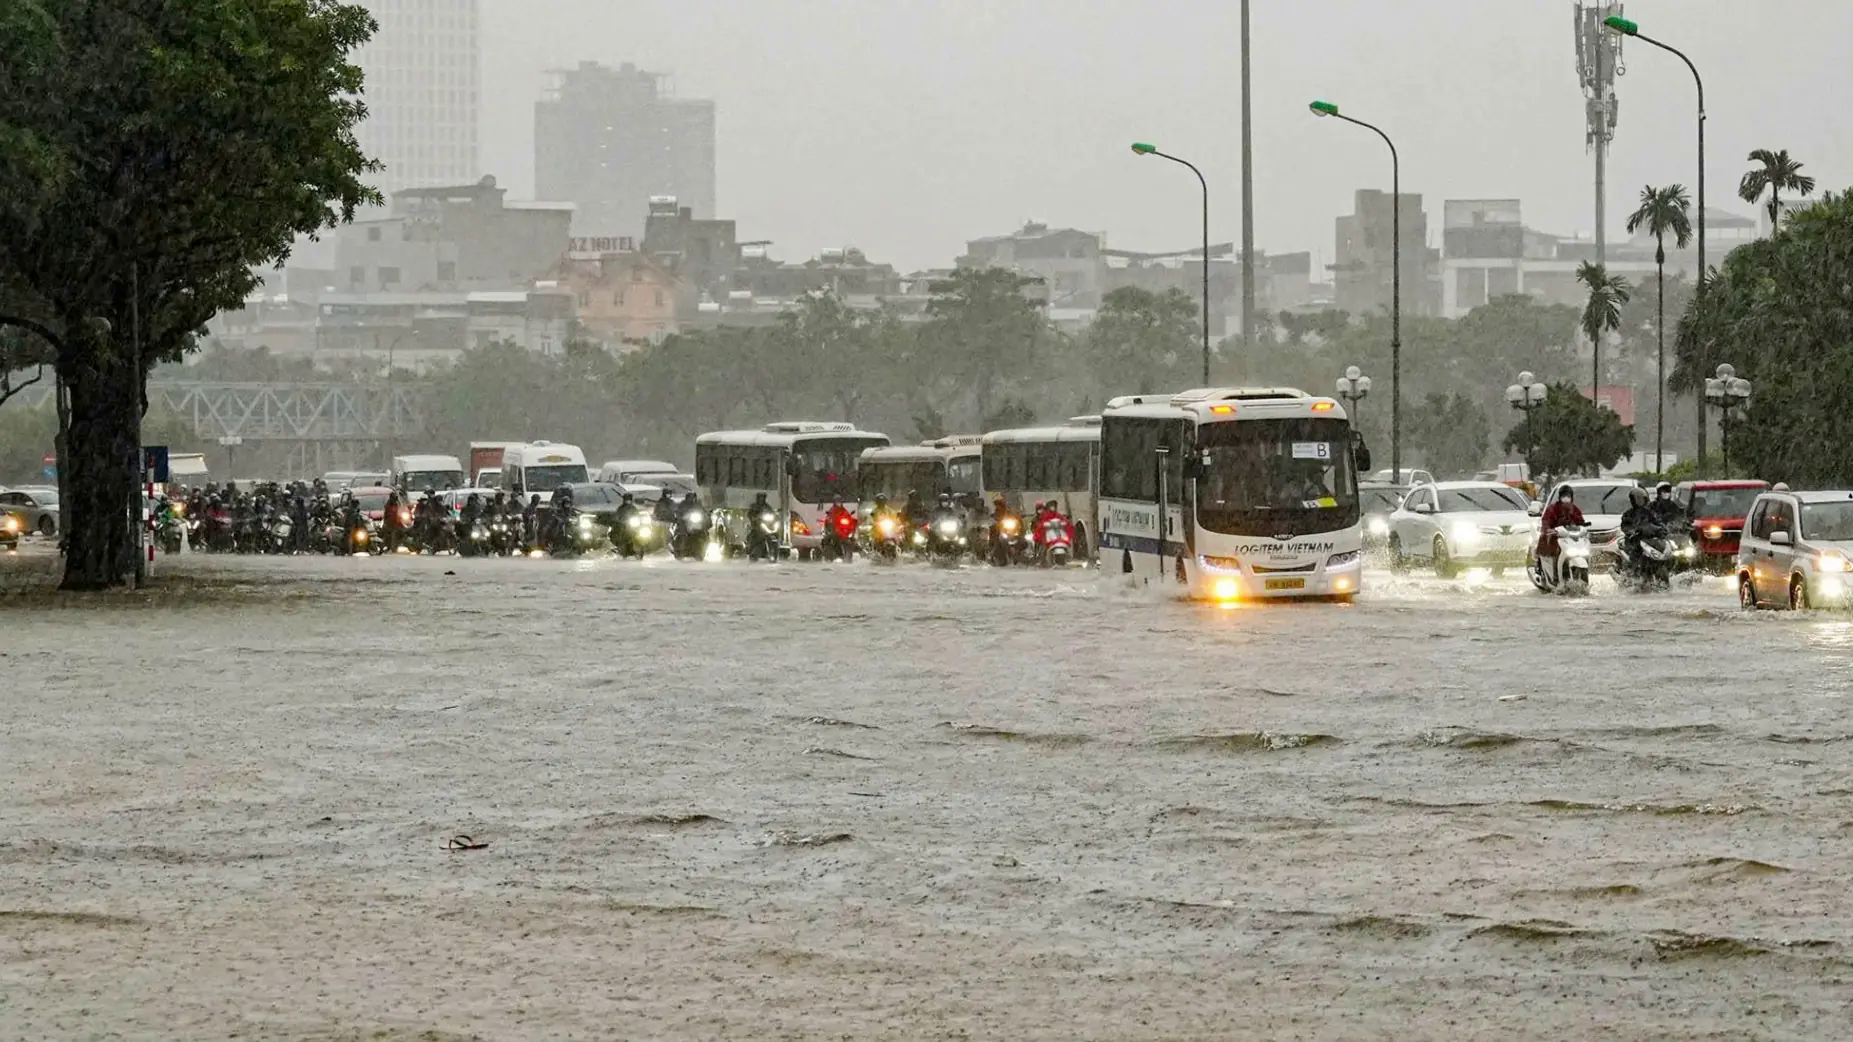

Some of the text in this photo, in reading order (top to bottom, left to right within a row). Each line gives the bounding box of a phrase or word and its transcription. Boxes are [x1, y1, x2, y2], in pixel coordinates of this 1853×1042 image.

[591, 236, 634, 251] HOTEL
[1317, 443, 1327, 457] B
[1234, 542, 1334, 556] LOGITEM VIETNAM
